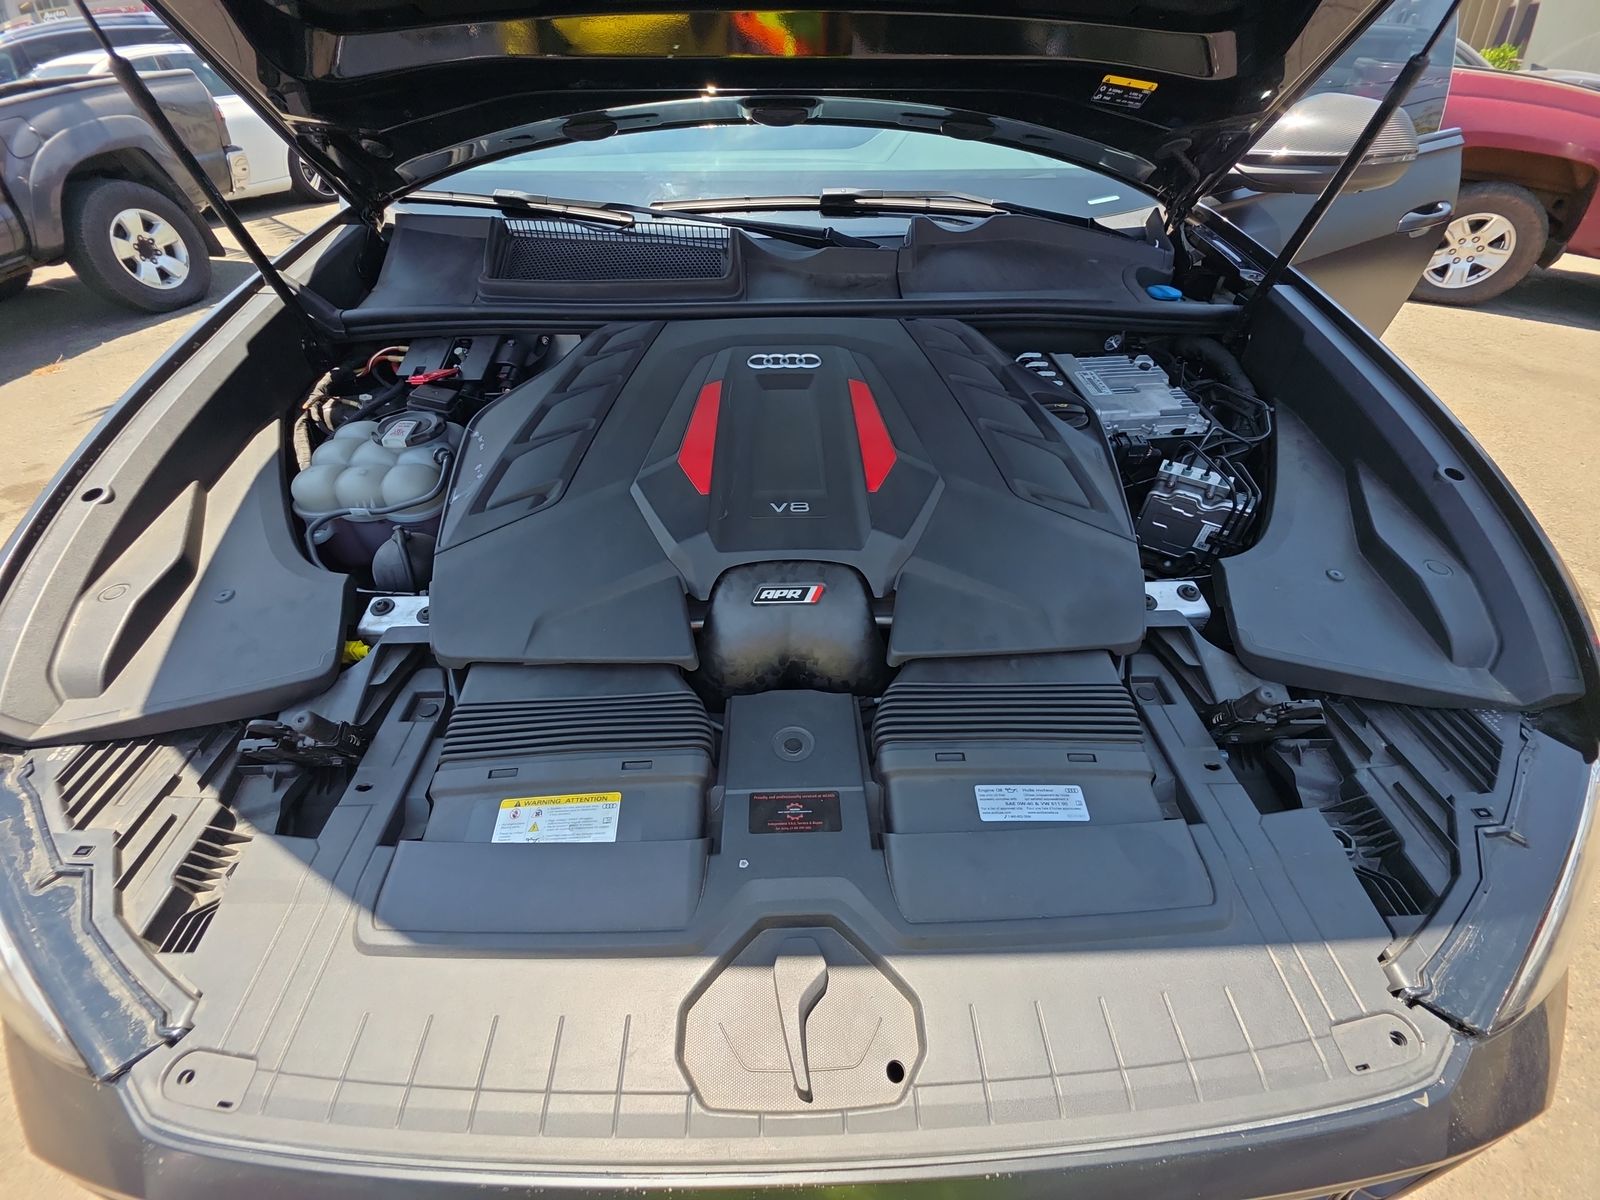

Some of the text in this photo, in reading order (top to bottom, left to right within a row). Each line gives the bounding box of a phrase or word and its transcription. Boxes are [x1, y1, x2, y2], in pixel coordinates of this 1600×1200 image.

[769, 502, 810, 513] V8
[759, 589, 802, 599] APR
[523, 796, 609, 807] WARNING ATTENTION
